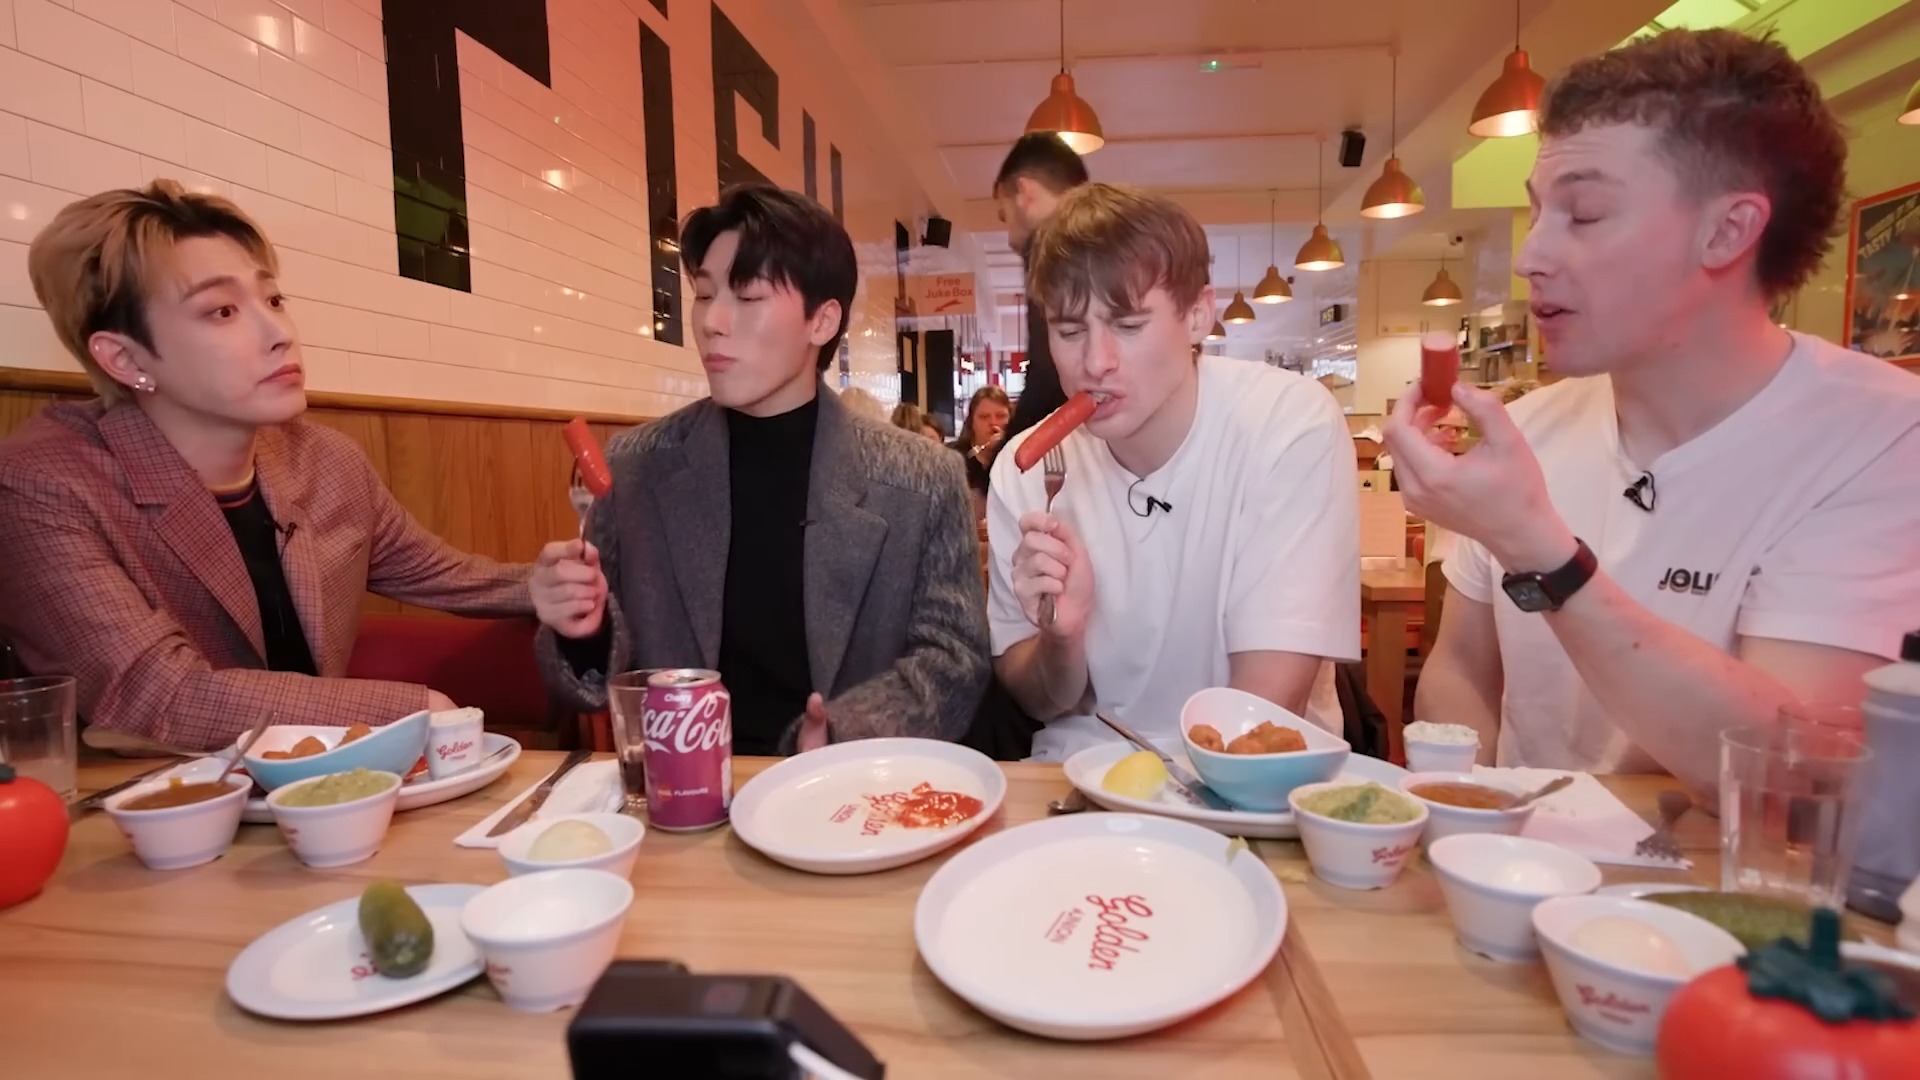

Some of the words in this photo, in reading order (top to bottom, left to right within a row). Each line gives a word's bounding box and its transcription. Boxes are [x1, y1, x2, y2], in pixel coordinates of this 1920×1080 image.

[936, 277, 961, 287] Free
[925, 289, 952, 299] Juke
[952, 287, 975, 297] Box
[1085, 894, 1153, 970] Golden
